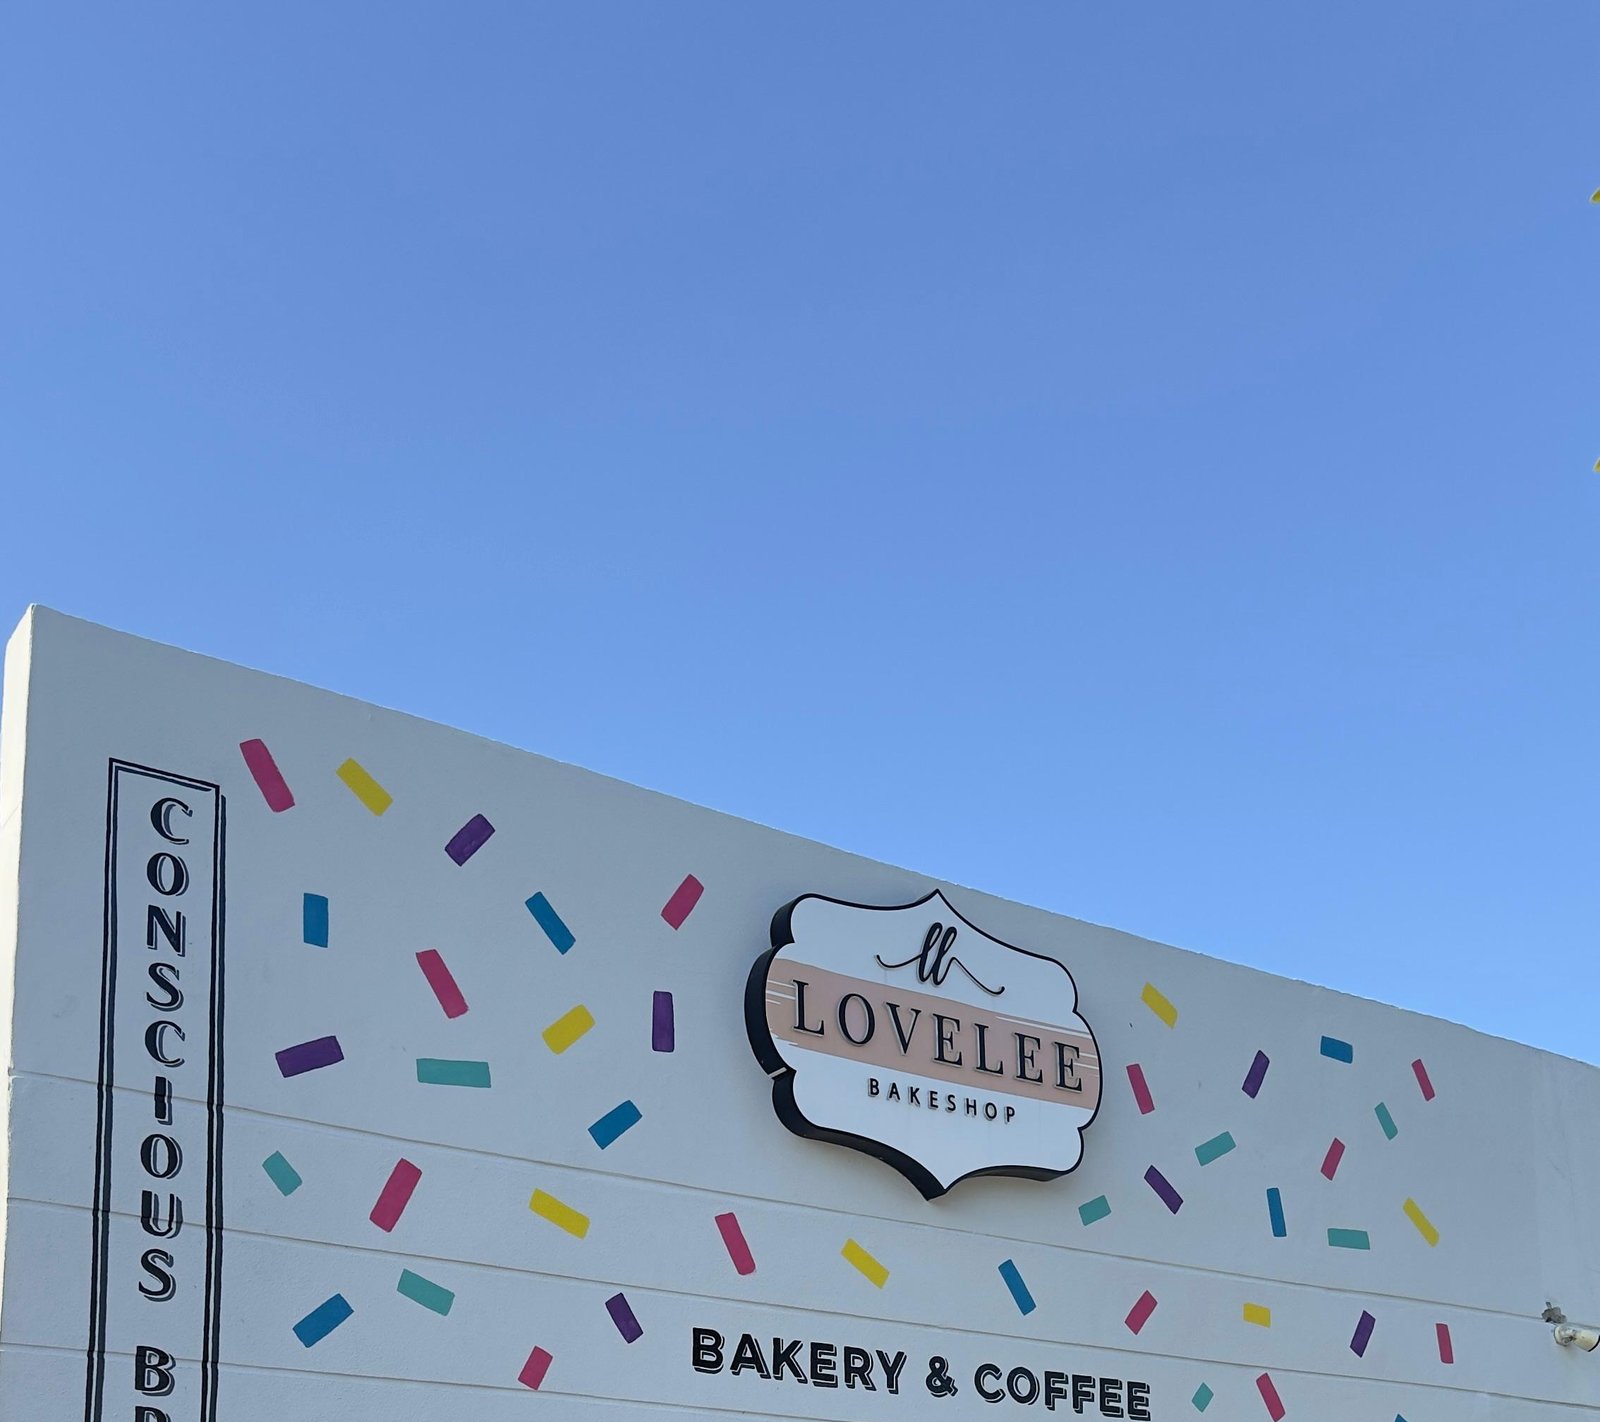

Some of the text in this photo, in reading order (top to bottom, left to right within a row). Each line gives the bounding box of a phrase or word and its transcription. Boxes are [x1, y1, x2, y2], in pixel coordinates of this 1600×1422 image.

[137, 796, 193, 1303] CONSCIOUS
[792, 979, 1083, 1092] LOVELEE
[869, 1077, 1017, 1123] BAKESHOP
[691, 1326, 1152, 1422] BAKERY & COFFEE
